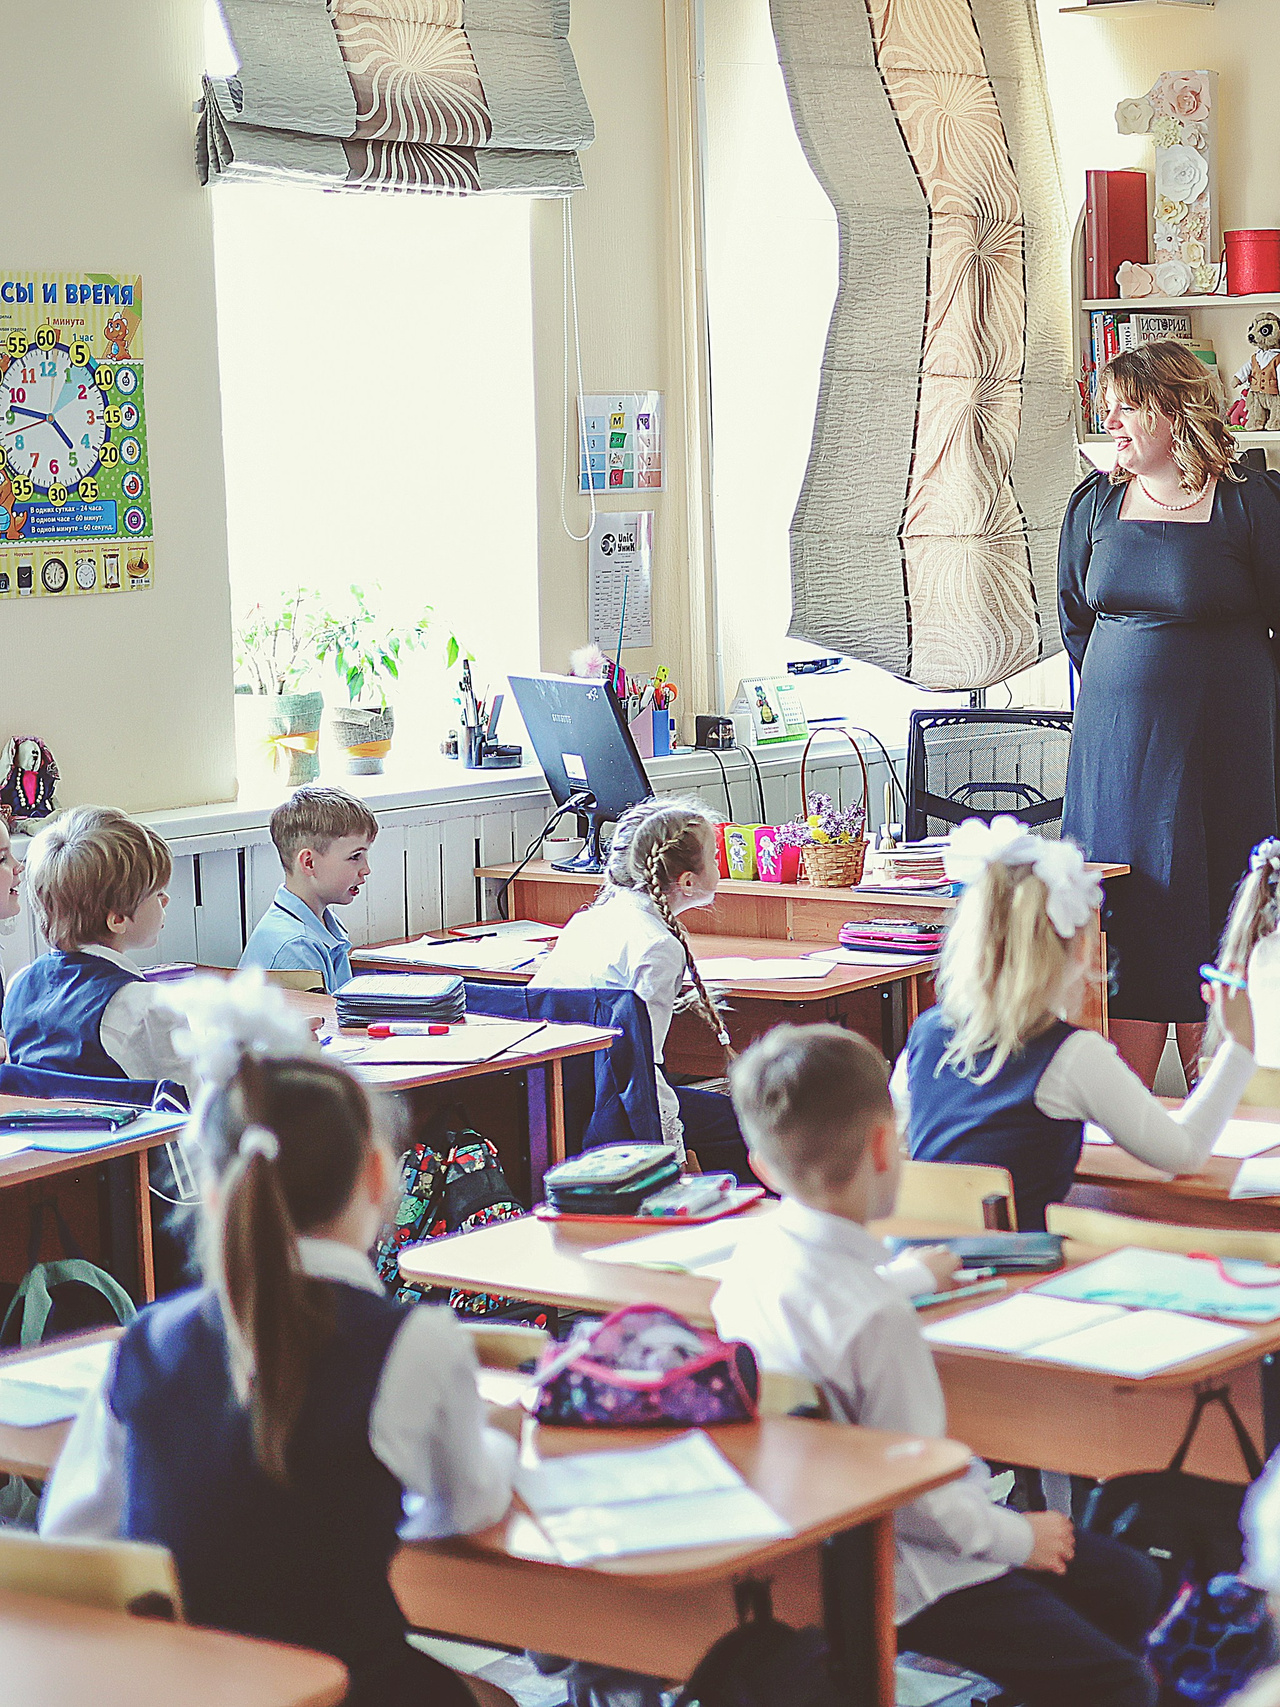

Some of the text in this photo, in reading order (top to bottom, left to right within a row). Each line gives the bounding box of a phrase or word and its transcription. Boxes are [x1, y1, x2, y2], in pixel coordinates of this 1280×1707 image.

[42, 282, 57, 304] И
[65, 282, 134, 305] ВРЕМЯ
[46, 316, 85, 328] 1 минута
[1141, 318, 1187, 331] ИСТОРИЯ
[37, 329, 54, 346] 60
[8, 337, 27, 354] 55
[75, 344, 86, 364] 5
[21, 368, 36, 383] 11
[40, 361, 57, 377] 12
[64, 367, 72, 382] 1
[96, 369, 113, 385] 10
[9, 387, 26, 403] 10
[78, 384, 87, 399] 2
[618, 402, 623, 411] 5
[86, 410, 95, 425] 3
[105, 410, 121, 424] 15
[613, 416, 621, 425] М
[590, 421, 596, 430] 4
[15, 434, 24, 450] 8
[81, 434, 90, 448] 4
[590, 439, 596, 448] 3
[30, 452, 39, 468] 7
[69, 452, 78, 467] 5
[100, 446, 118, 462] 20
[647, 457, 652, 466] 2
[49, 459, 59, 475] 6
[590, 458, 596, 467] 2
[14, 480, 32, 496] 35
[50, 488, 66, 502] 30
[80, 482, 98, 498] 25
[618, 532, 634, 543] UniC
